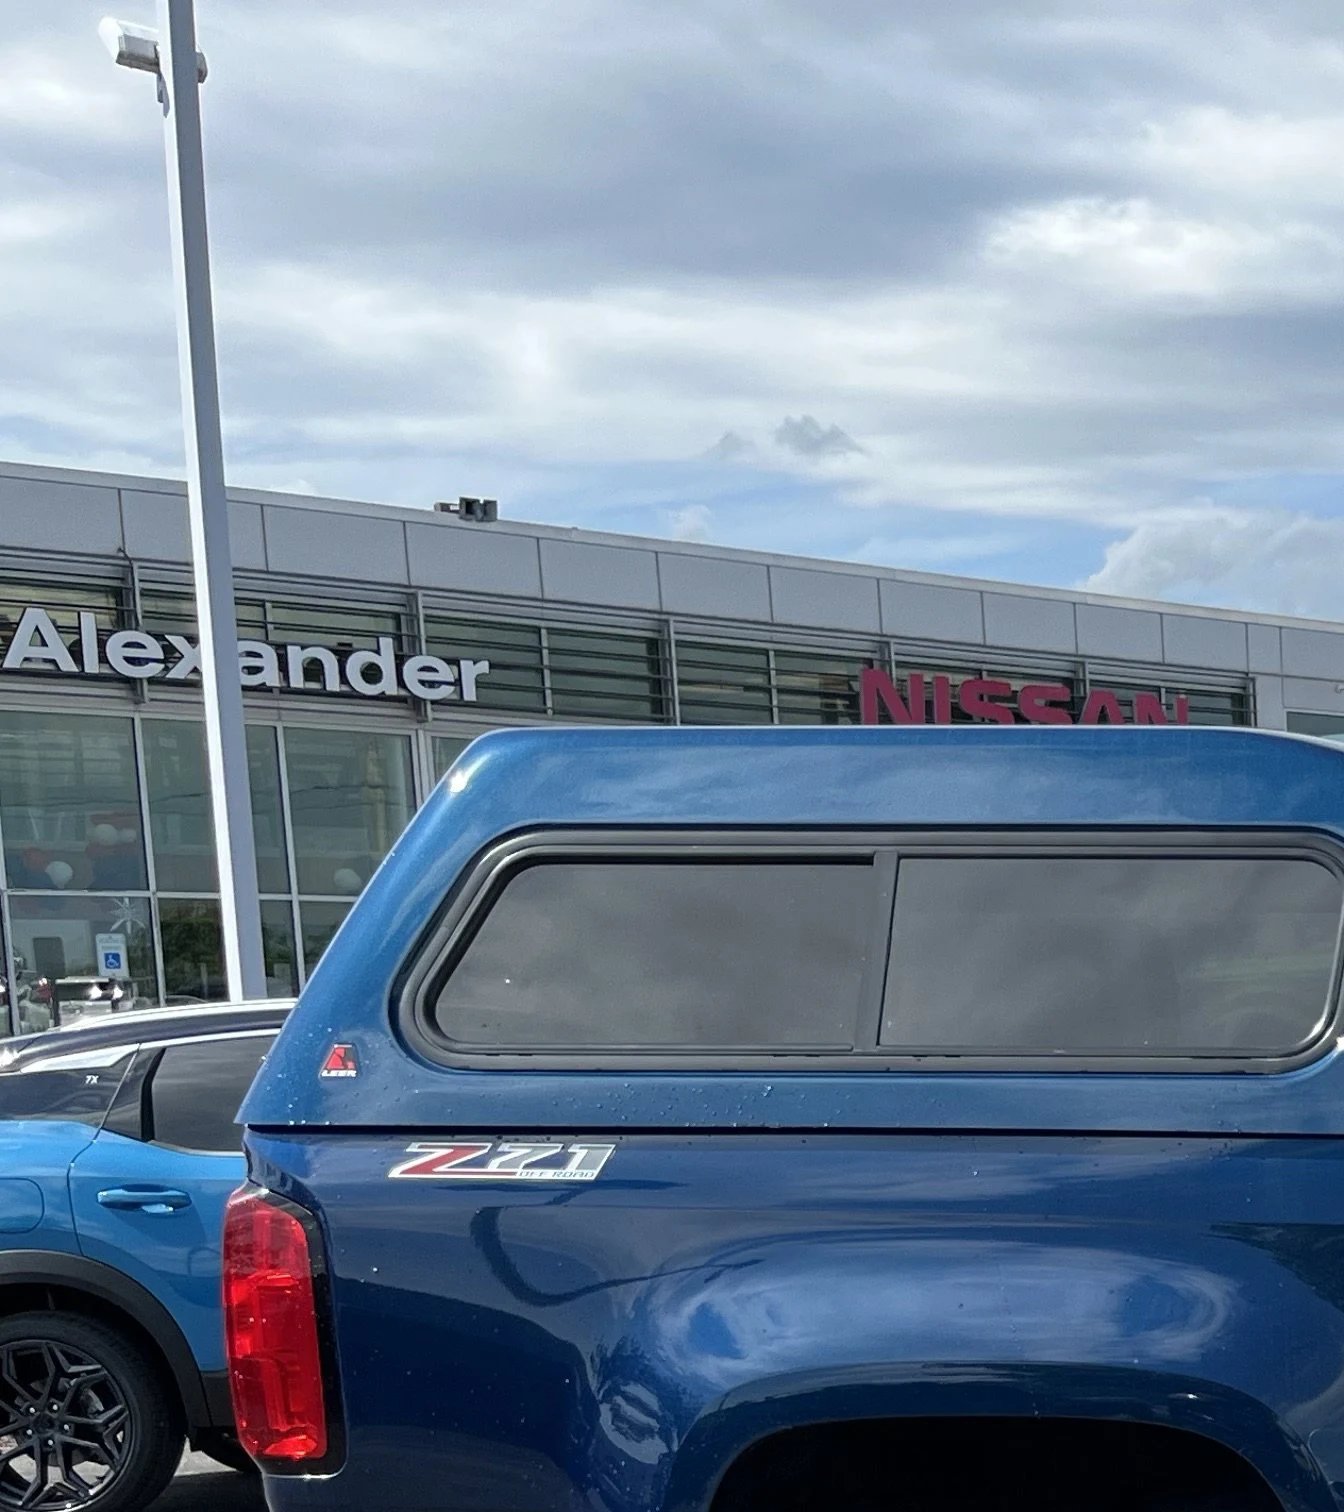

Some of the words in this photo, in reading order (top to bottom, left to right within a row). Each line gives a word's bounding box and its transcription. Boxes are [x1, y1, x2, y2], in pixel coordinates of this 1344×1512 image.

[2, 607, 490, 701] Alexander
[859, 668, 1189, 725] NISSAN
[388, 1142, 613, 1180] Z71
[519, 1170, 549, 1178] OFF
[551, 1170, 595, 1178] ROAD
